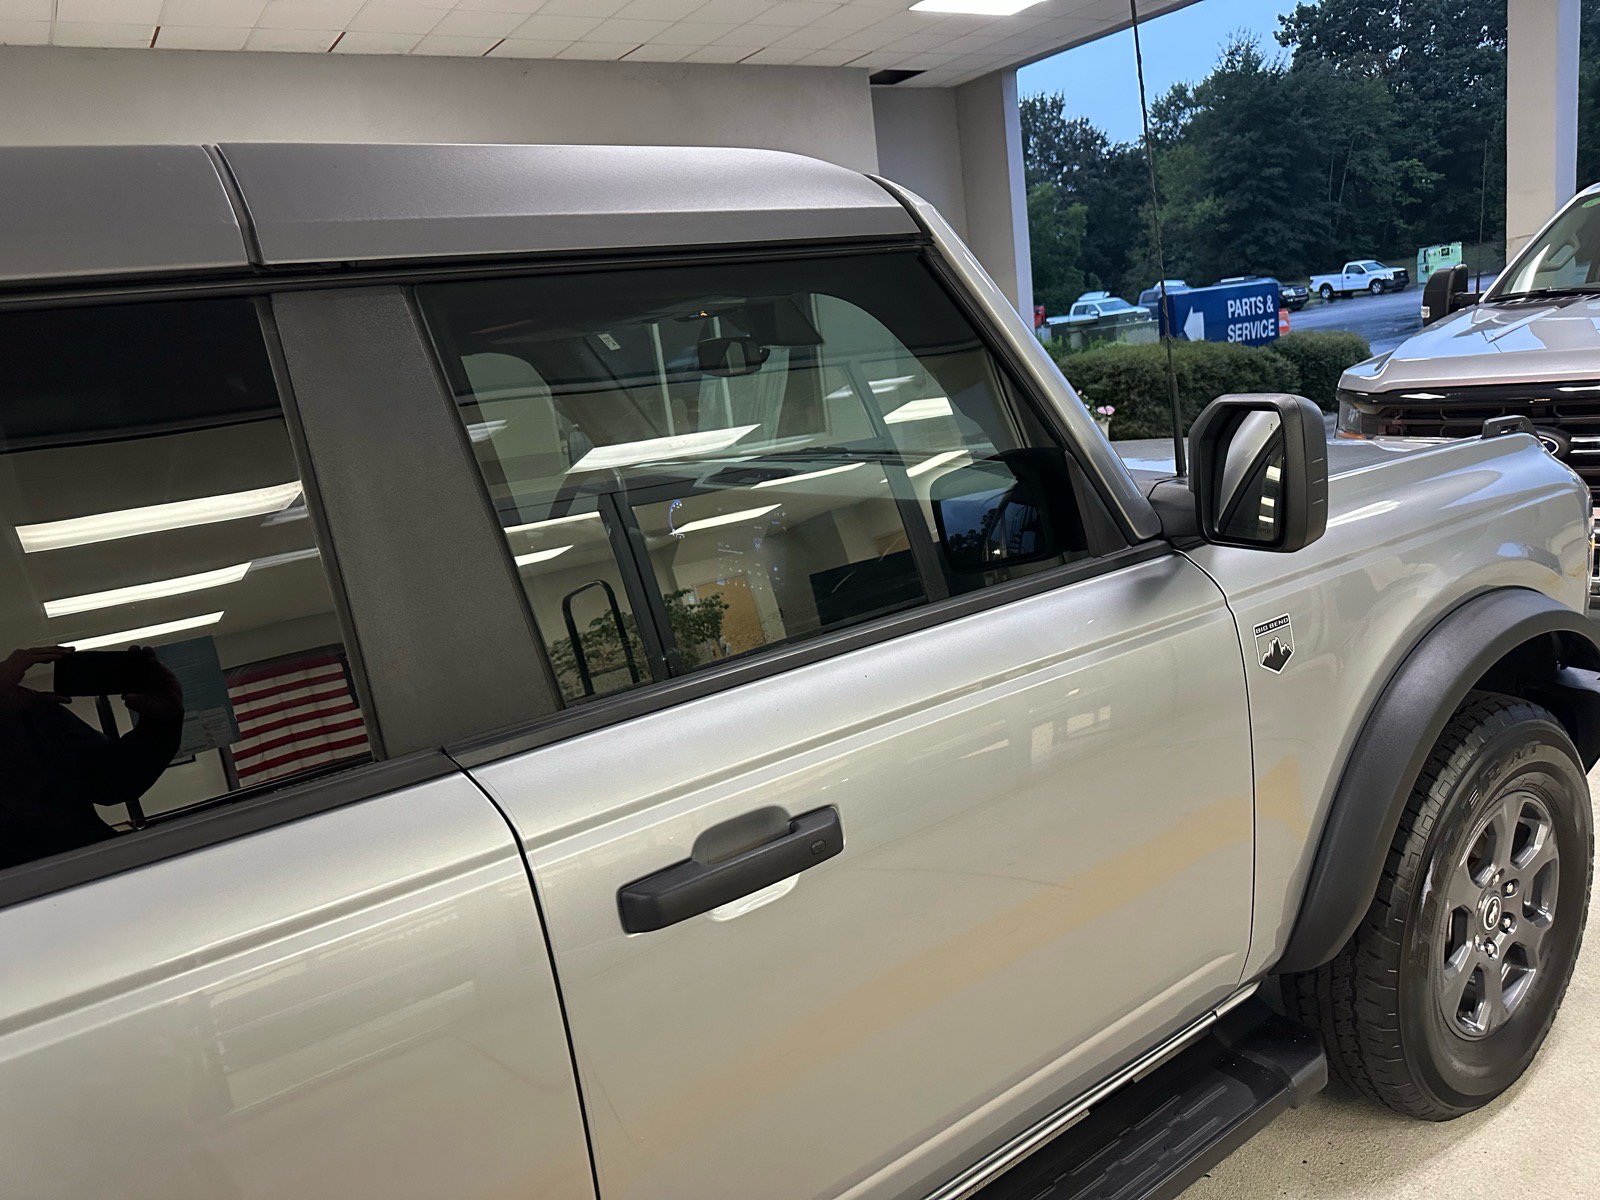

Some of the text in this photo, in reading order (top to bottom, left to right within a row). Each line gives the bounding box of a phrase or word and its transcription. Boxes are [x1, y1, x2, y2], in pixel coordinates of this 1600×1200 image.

[1227, 294, 1274, 319] PARTS &
[1227, 318, 1275, 343] SERVICE
[1255, 617, 1289, 634] BIG BEND
